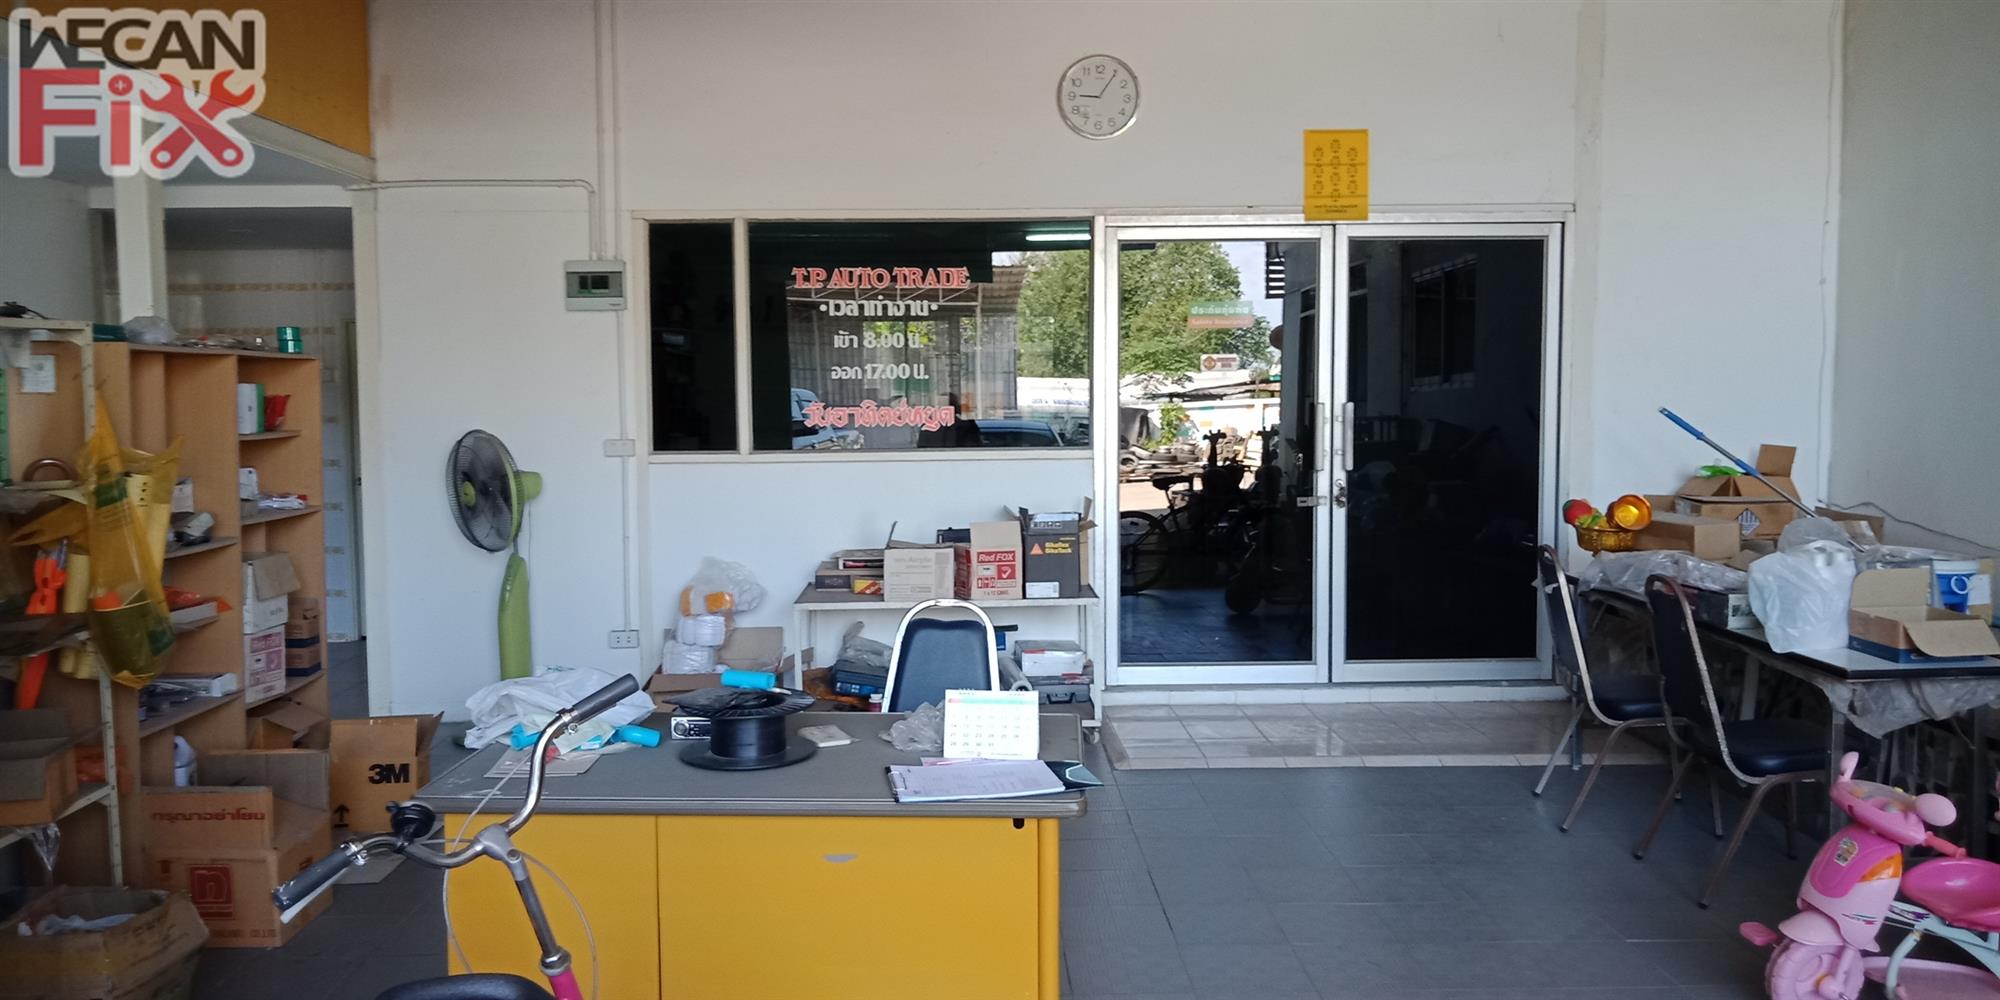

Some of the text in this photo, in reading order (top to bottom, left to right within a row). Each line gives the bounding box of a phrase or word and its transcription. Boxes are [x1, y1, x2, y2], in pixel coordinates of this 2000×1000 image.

[1082, 66, 1091, 76] 11
[1095, 64, 1106, 74] 12
[1071, 78, 1082, 88] 10
[1119, 79, 1128, 89] 2
[1068, 90, 1077, 101] 9
[1123, 93, 1132, 104] 3
[1071, 105, 1080, 115] 8
[1118, 107, 1126, 116] 4
[1094, 120, 1103, 130] 6
[1107, 117, 1116, 127] 5
[827, 267, 891, 289] AUTO
[892, 266, 971, 290] TRADE
[862, 331, 905, 349] 8.00
[831, 365, 863, 380] ออก
[864, 363, 911, 380] 17.00
[803, 399, 956, 432] วันอาทิตย์หยุด
[978, 552, 1014, 562] Red FOX
[367, 763, 410, 784] 3M
